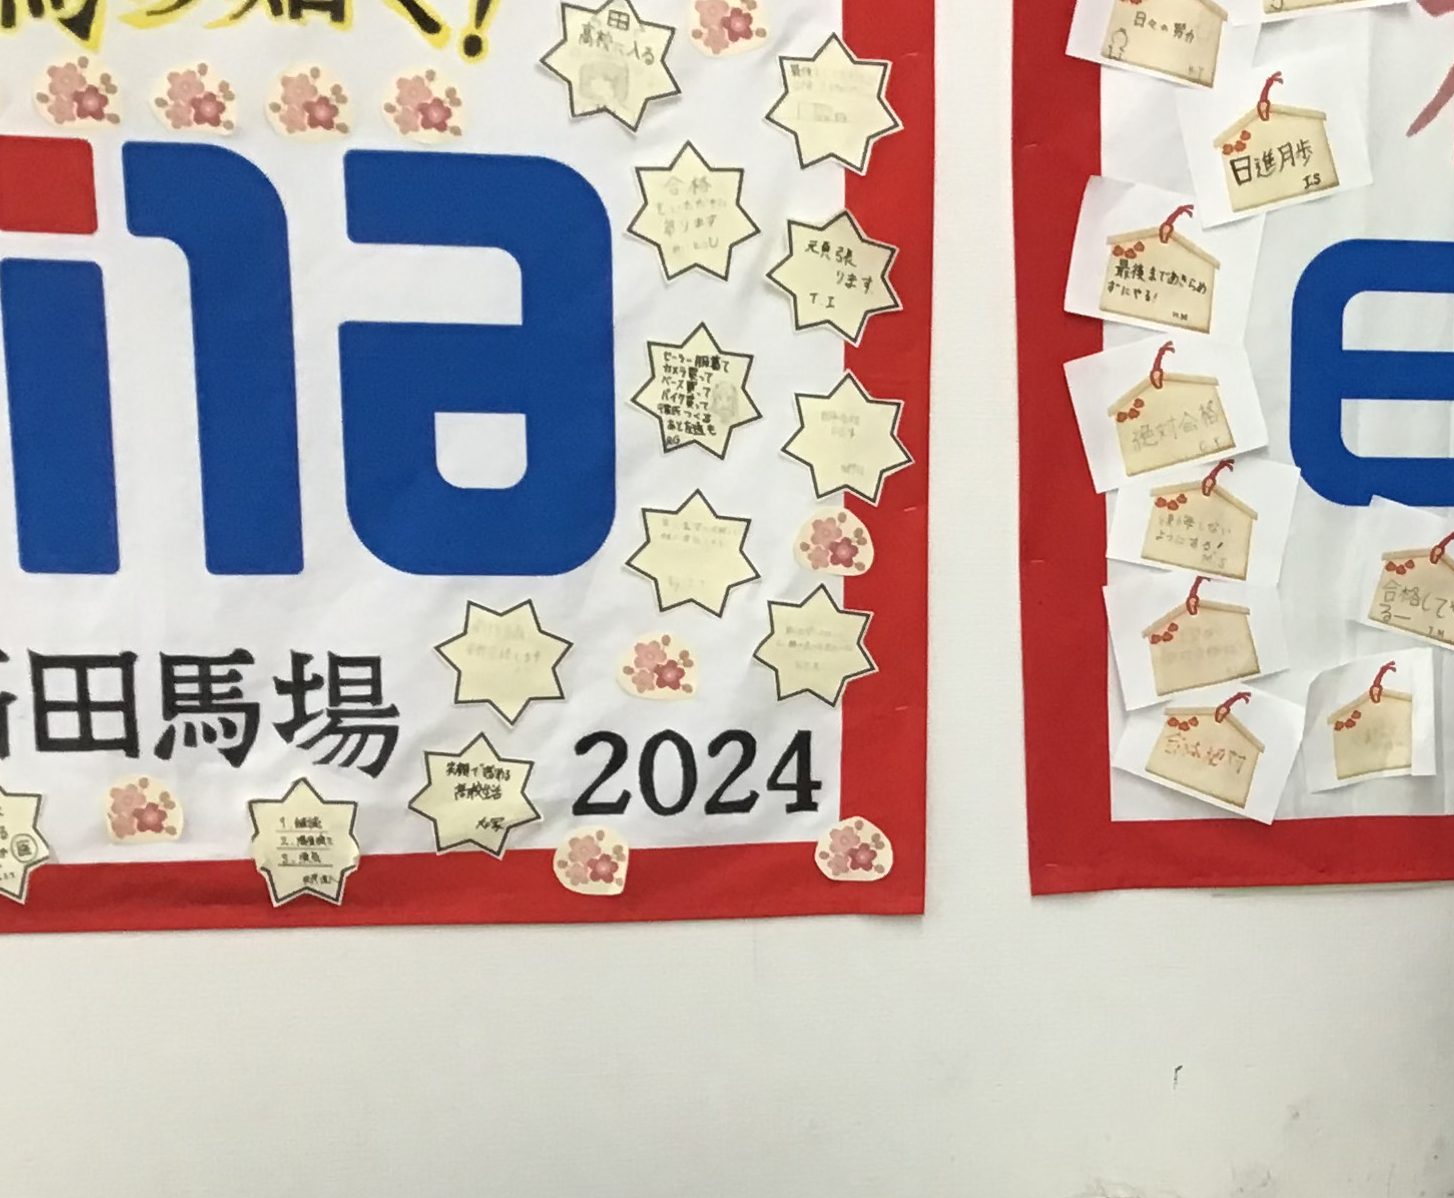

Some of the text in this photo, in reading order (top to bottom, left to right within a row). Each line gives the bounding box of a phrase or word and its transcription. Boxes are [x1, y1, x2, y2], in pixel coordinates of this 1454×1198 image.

[1133, 11, 1195, 44] 日々の努力
[1229, 139, 1314, 186] 日進月歩
[1115, 258, 1208, 295] 最後まであきらめ
[0, 647, 400, 779] 田馬場
[572, 729, 823, 816] 2024
